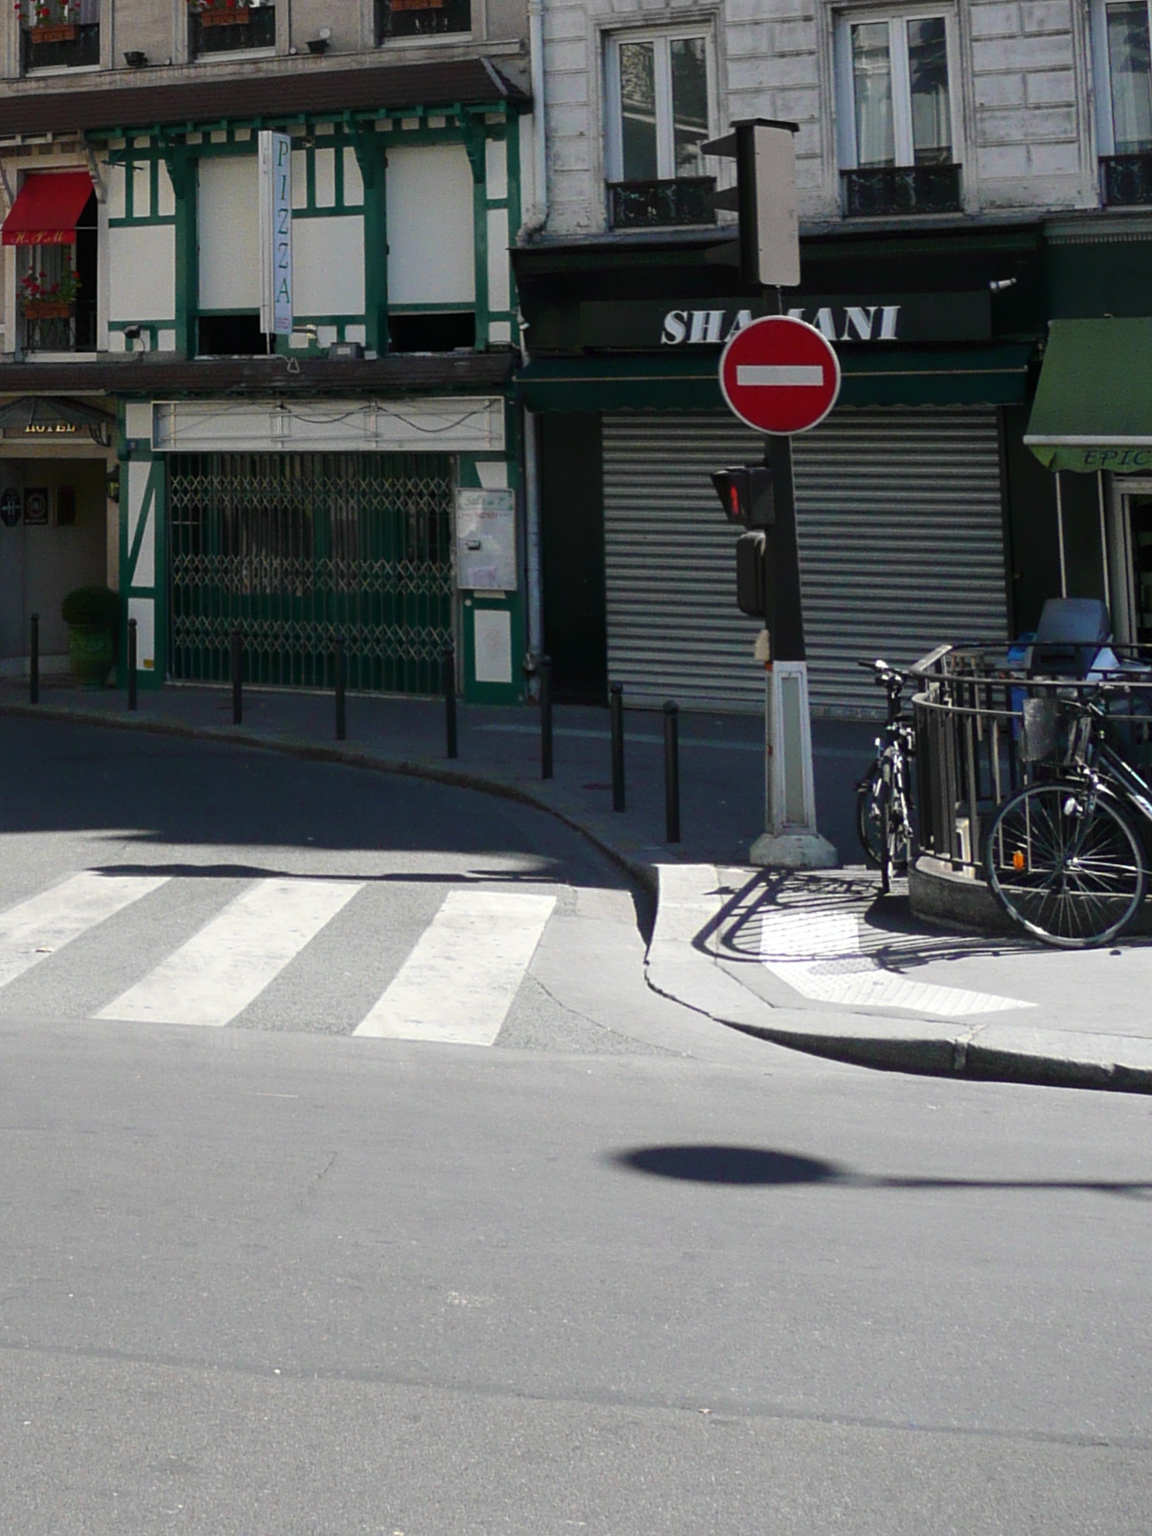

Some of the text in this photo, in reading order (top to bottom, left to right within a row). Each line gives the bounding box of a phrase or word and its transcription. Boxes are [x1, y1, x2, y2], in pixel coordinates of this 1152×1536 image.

[276, 140, 290, 303] PIZZA
[660, 305, 901, 345] SHAANI
[1084, 449, 1152, 466] EPIC
